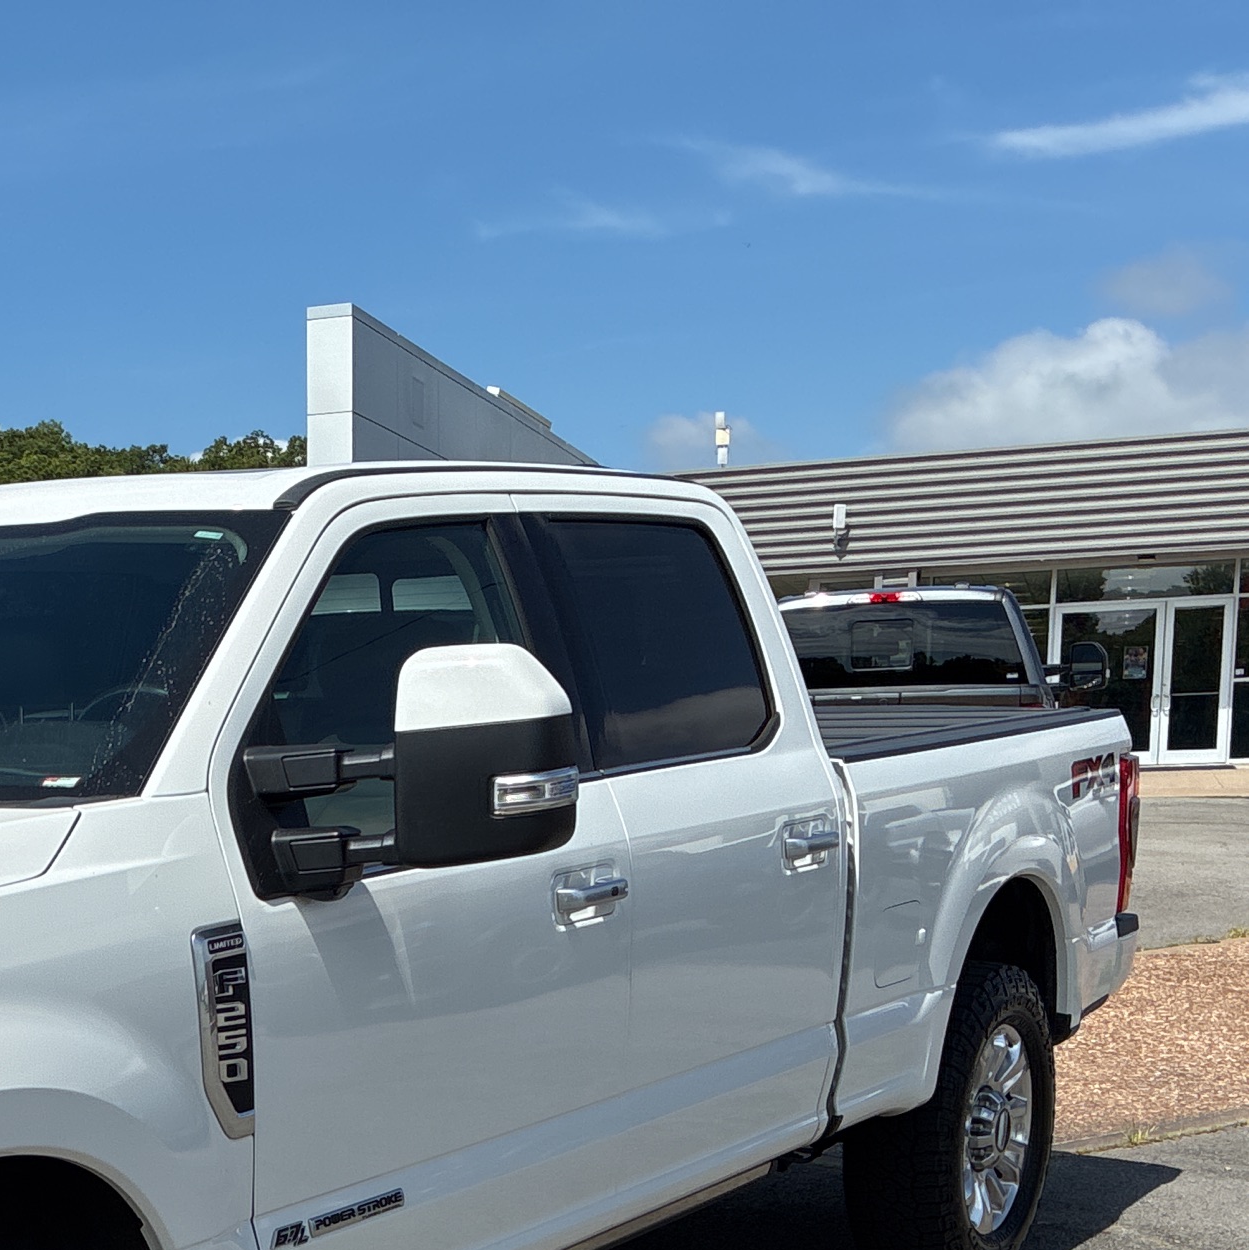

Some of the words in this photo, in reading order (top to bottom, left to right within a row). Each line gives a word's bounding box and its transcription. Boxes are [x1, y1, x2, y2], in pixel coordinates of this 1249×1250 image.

[1071, 751, 1116, 799] FX4
[208, 936, 243, 951] LIMITED
[314, 1207, 356, 1231] POWER
[356, 1191, 403, 1216] STROKE
